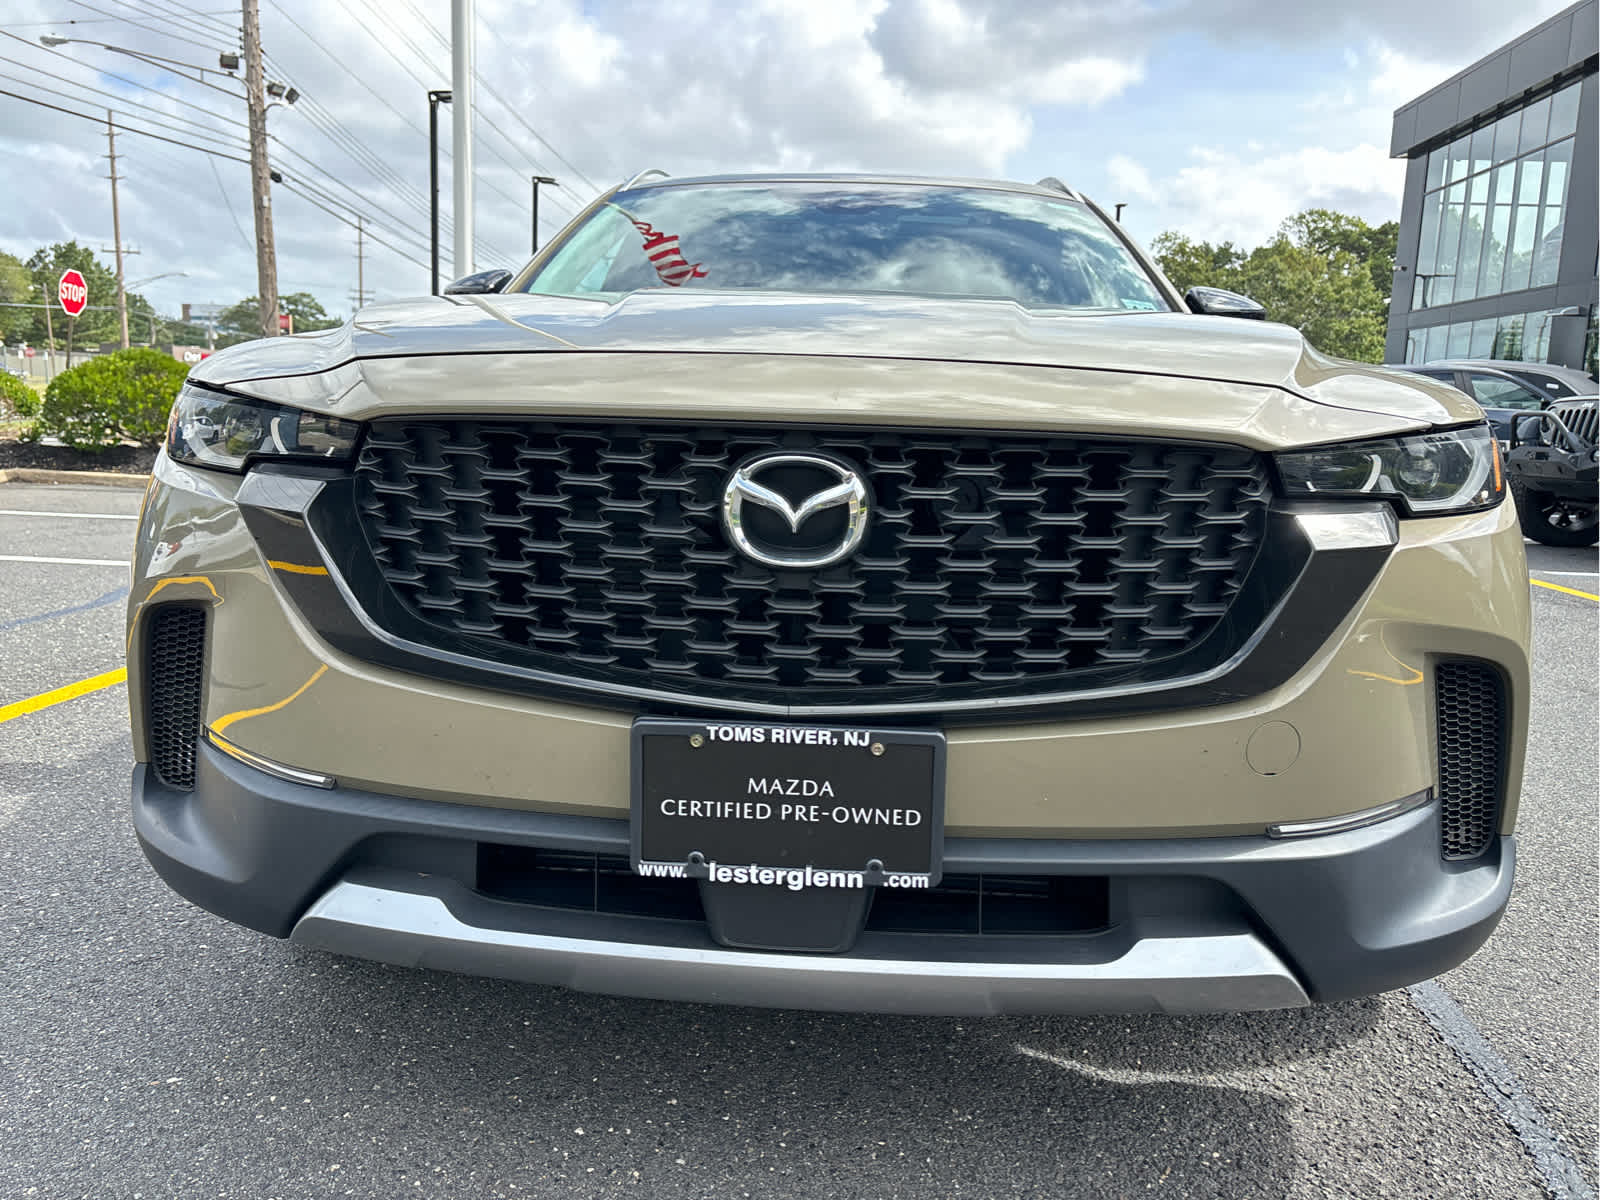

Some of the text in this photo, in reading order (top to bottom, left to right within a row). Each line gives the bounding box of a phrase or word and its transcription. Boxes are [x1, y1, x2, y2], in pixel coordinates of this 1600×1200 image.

[61, 282, 85, 303] STOP
[706, 726, 871, 747] TOMS RIVER, NJ
[747, 778, 835, 797] MAZDA
[660, 799, 922, 826] CERTIFIED PRE-OWNED
[638, 862, 929, 890] www. lesterglenn .com
